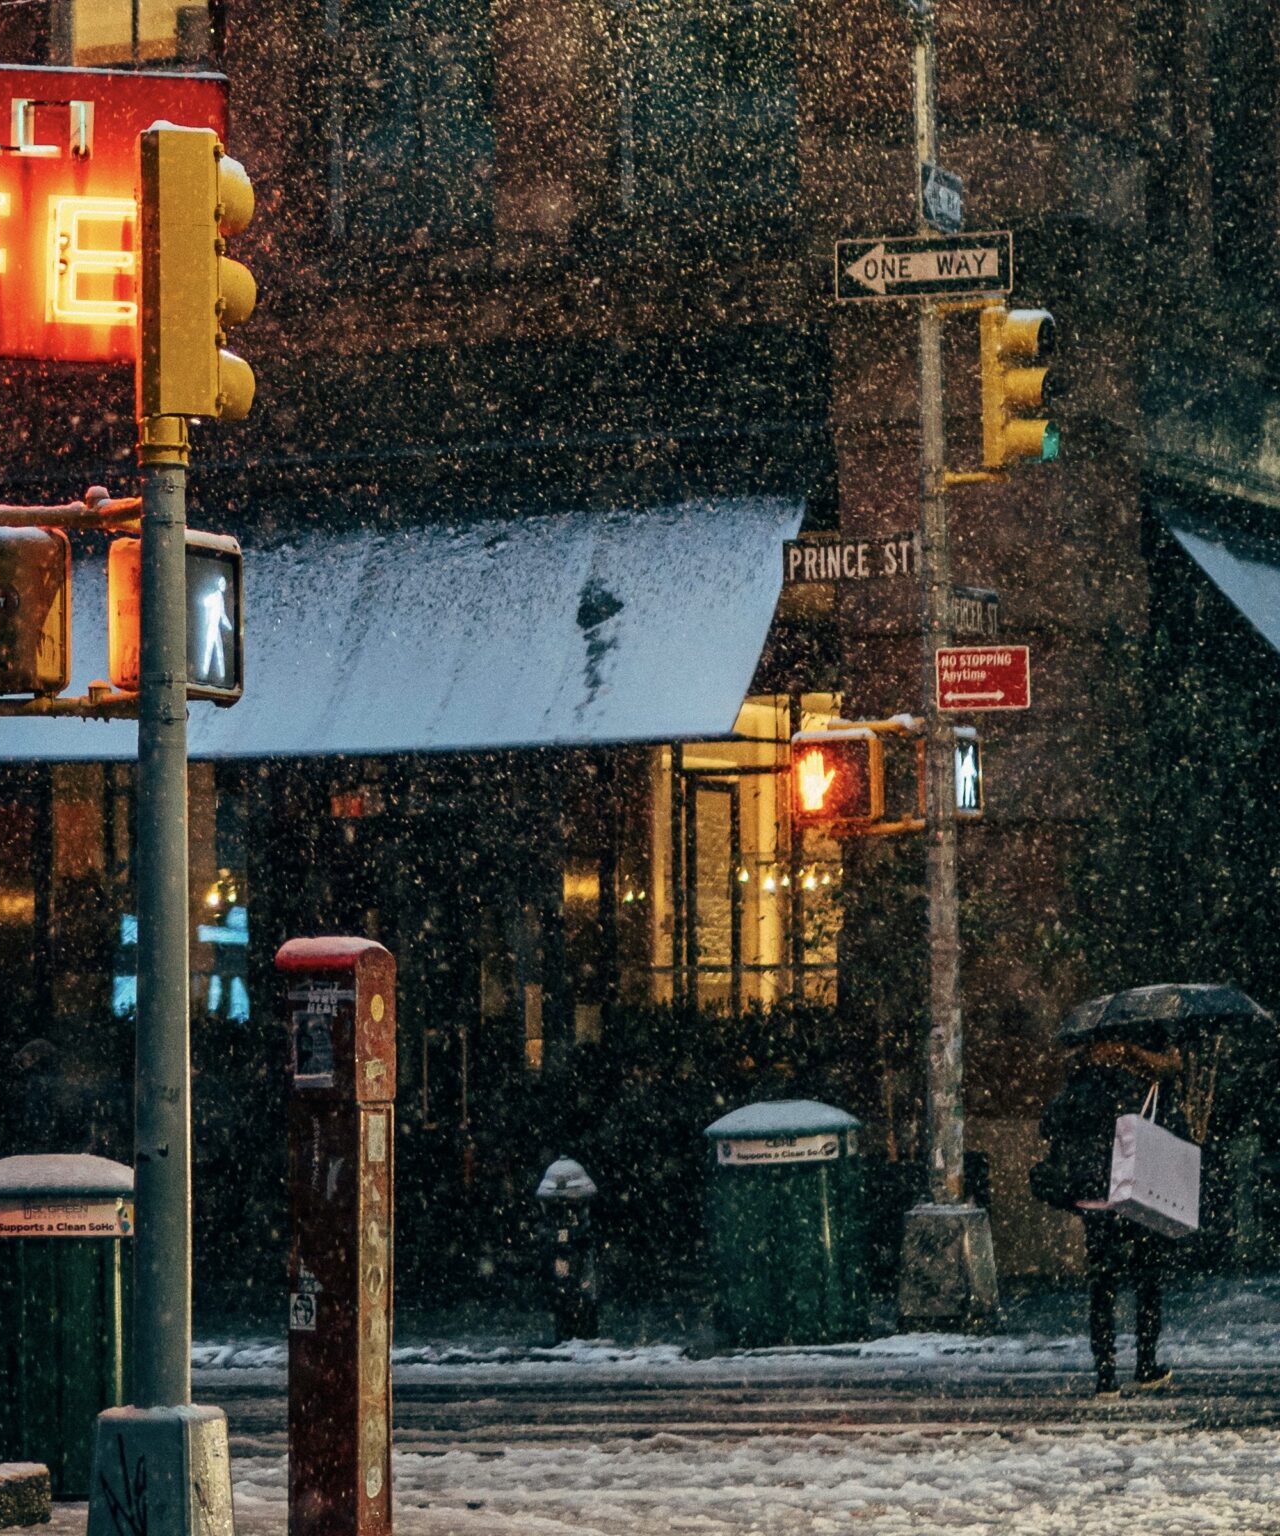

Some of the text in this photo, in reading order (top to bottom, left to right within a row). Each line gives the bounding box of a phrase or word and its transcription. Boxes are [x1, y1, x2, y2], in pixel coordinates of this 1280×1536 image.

[864, 251, 988, 281] ONE WAY
[788, 540, 911, 581] PRINCE ST
[941, 653, 1012, 668] NO STOPPING
[942, 669, 987, 683] Anytime
[47, 1224, 54, 1232] a
[56, 1222, 86, 1232] Clean
